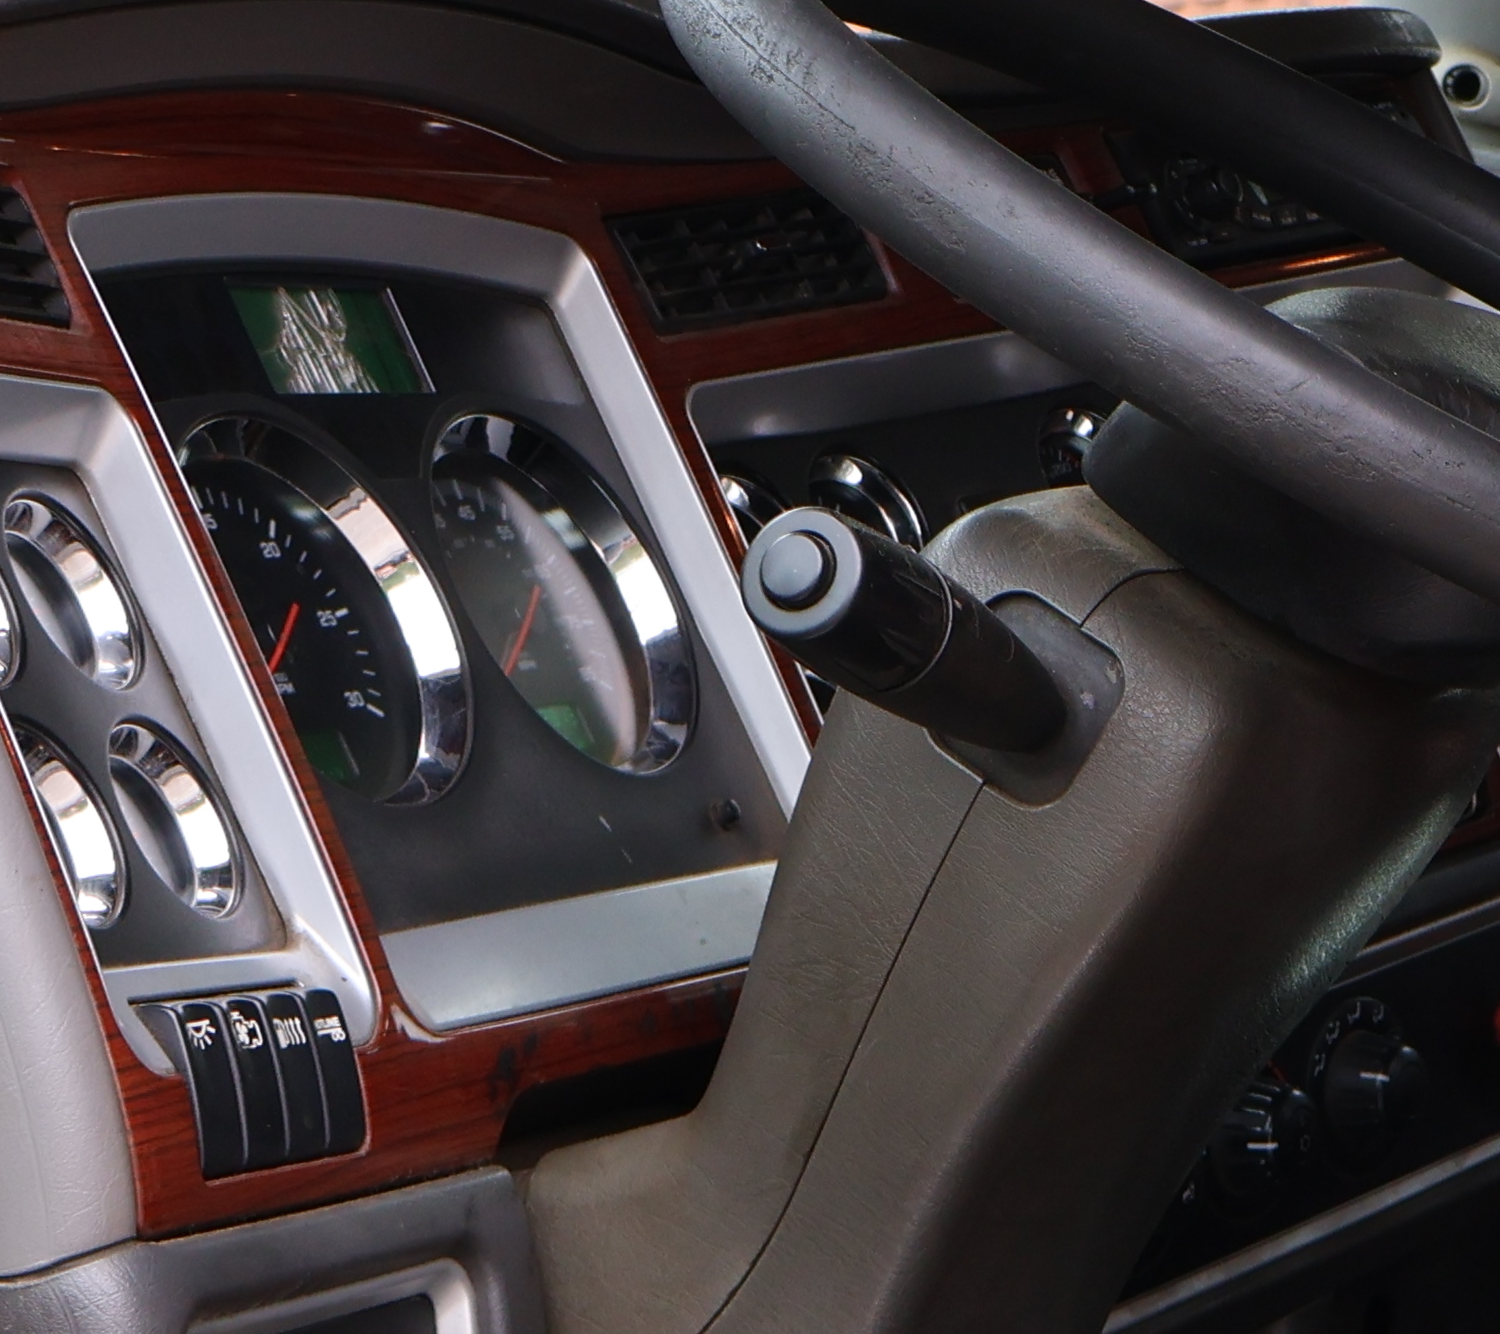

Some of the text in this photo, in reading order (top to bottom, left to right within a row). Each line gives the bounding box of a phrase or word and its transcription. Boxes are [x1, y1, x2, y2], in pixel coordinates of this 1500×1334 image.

[259, 541, 281, 559] 20
[316, 610, 338, 627] 25
[343, 691, 365, 708] 30
